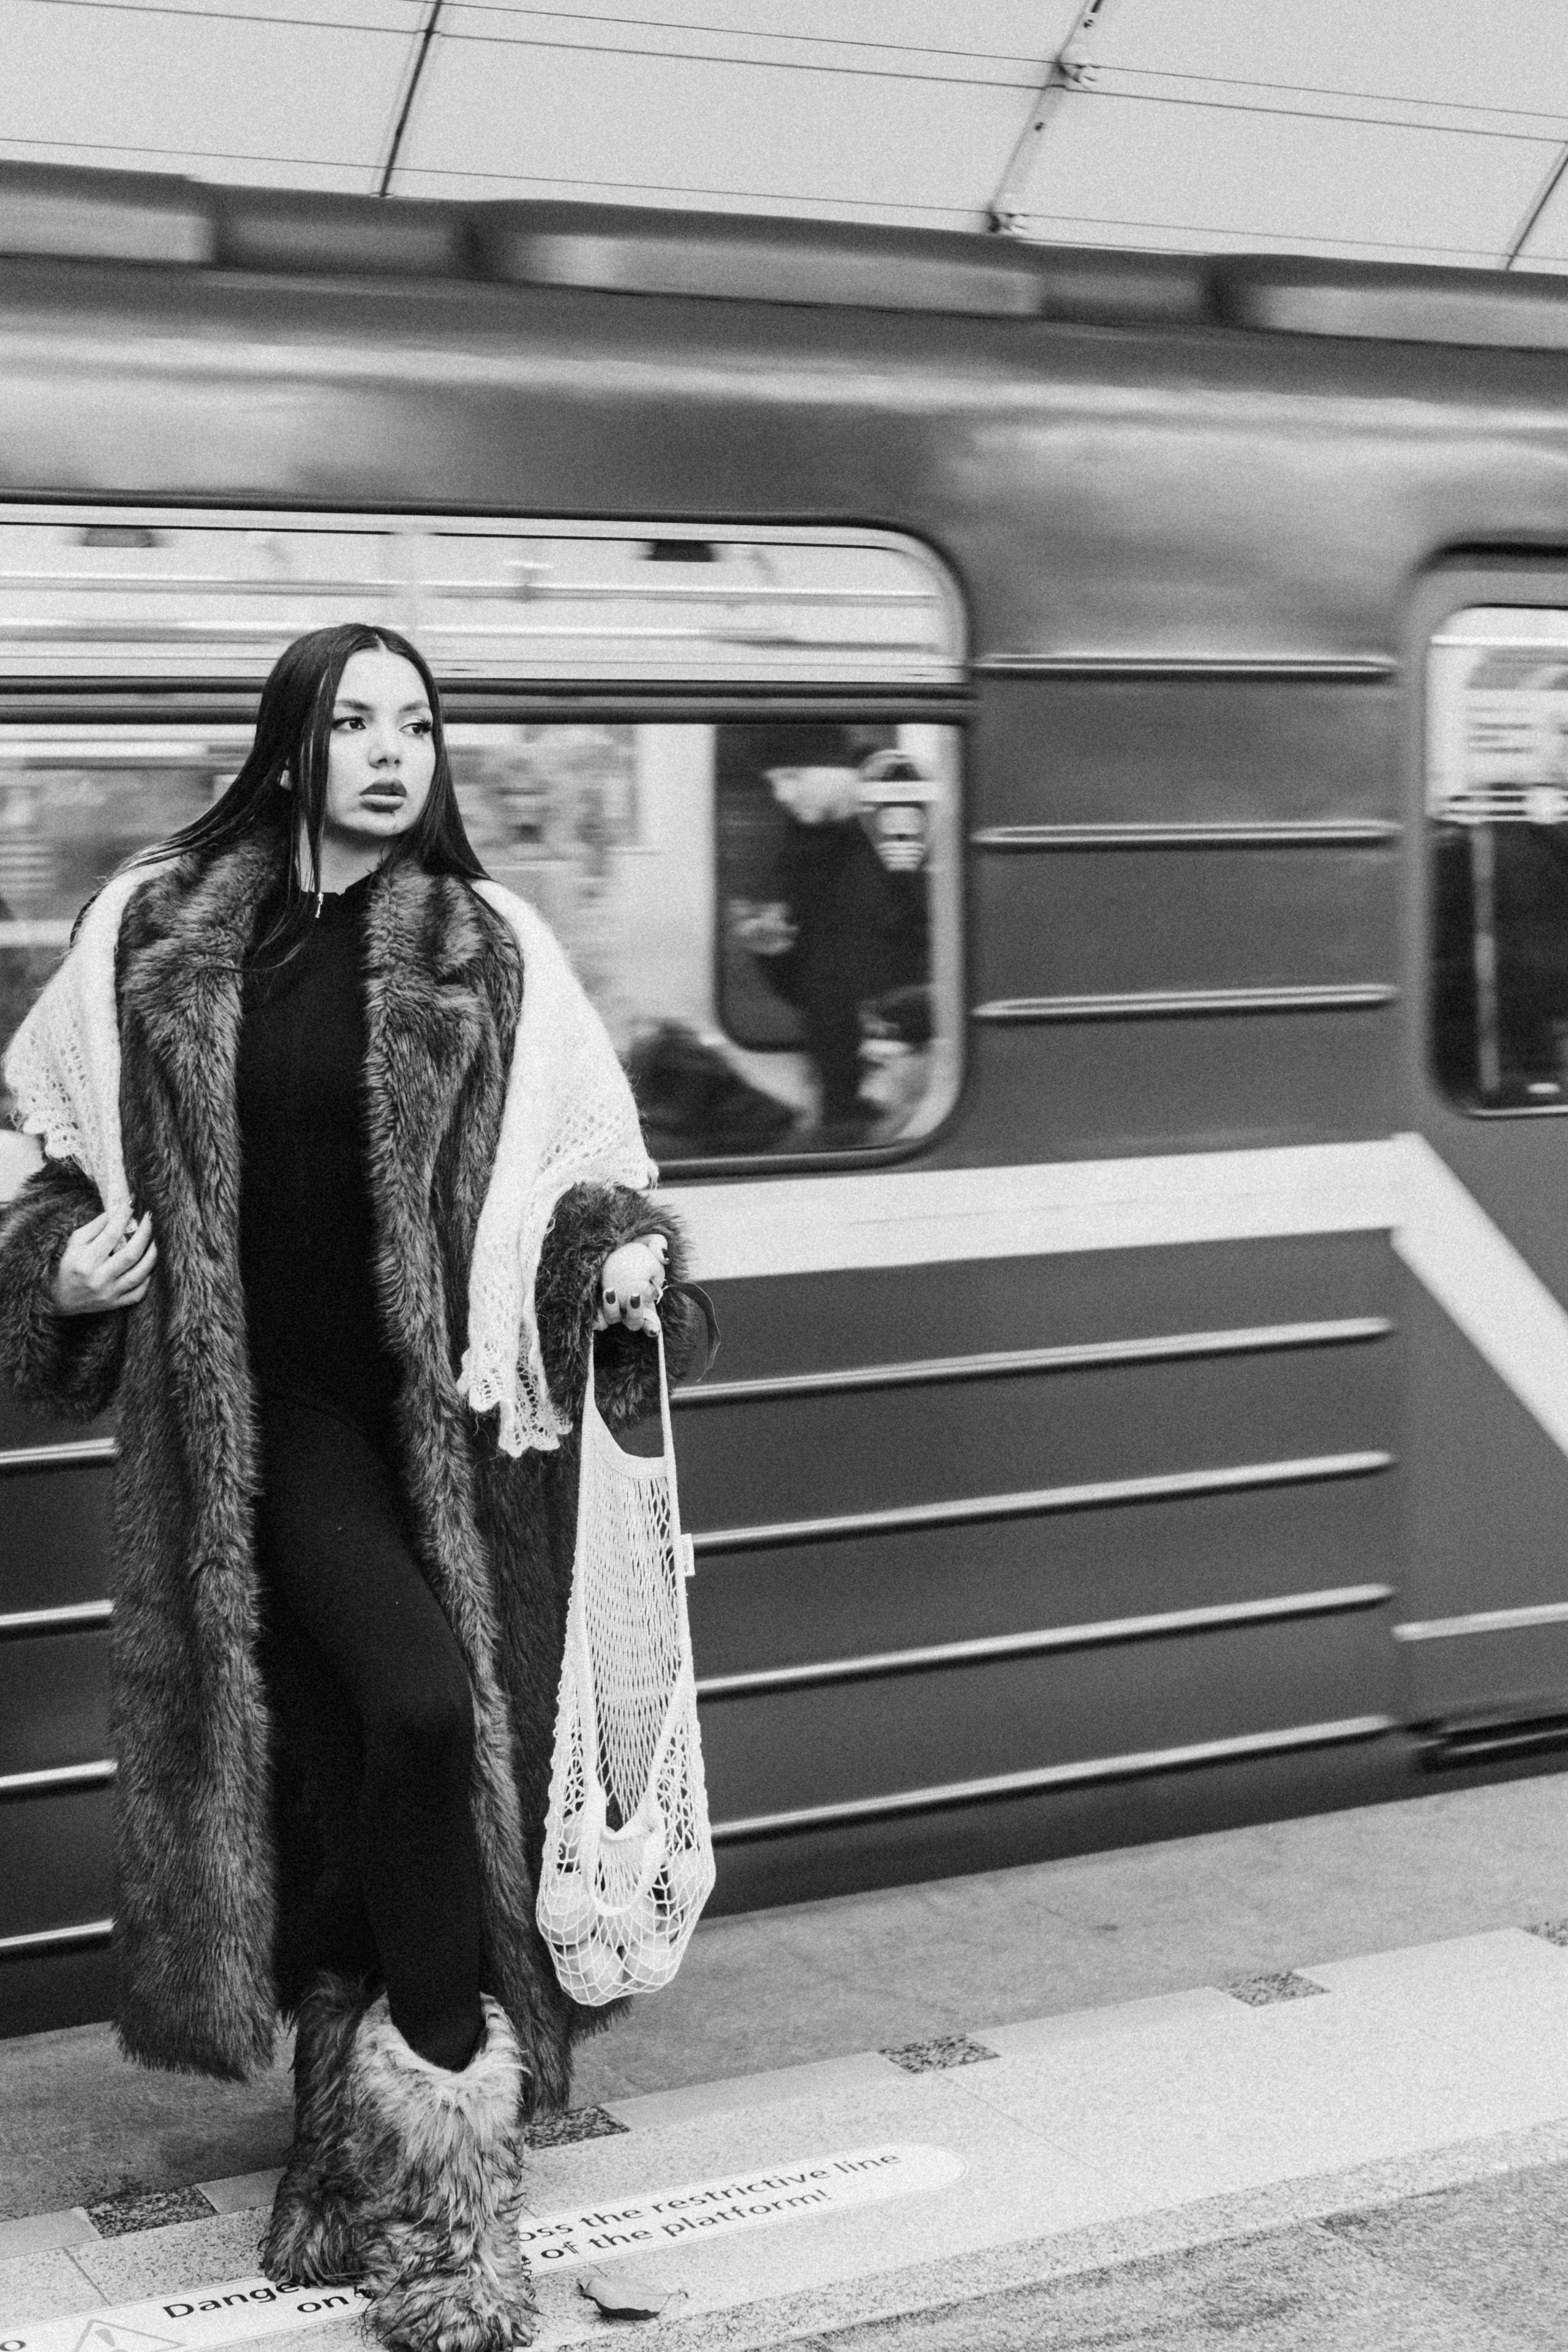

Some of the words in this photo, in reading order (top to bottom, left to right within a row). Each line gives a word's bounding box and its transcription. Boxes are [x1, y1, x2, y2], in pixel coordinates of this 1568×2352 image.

[163, 2283, 306, 2318] Dange
[519, 2224, 574, 2242] oss
[579, 2210, 644, 2227] the
[651, 2170, 831, 2213] restrictive
[833, 2156, 902, 2174] line
[296, 2296, 350, 2313] on
[541, 2241, 579, 2259] of
[587, 2230, 654, 2248] the
[661, 2189, 833, 2237] platform!
